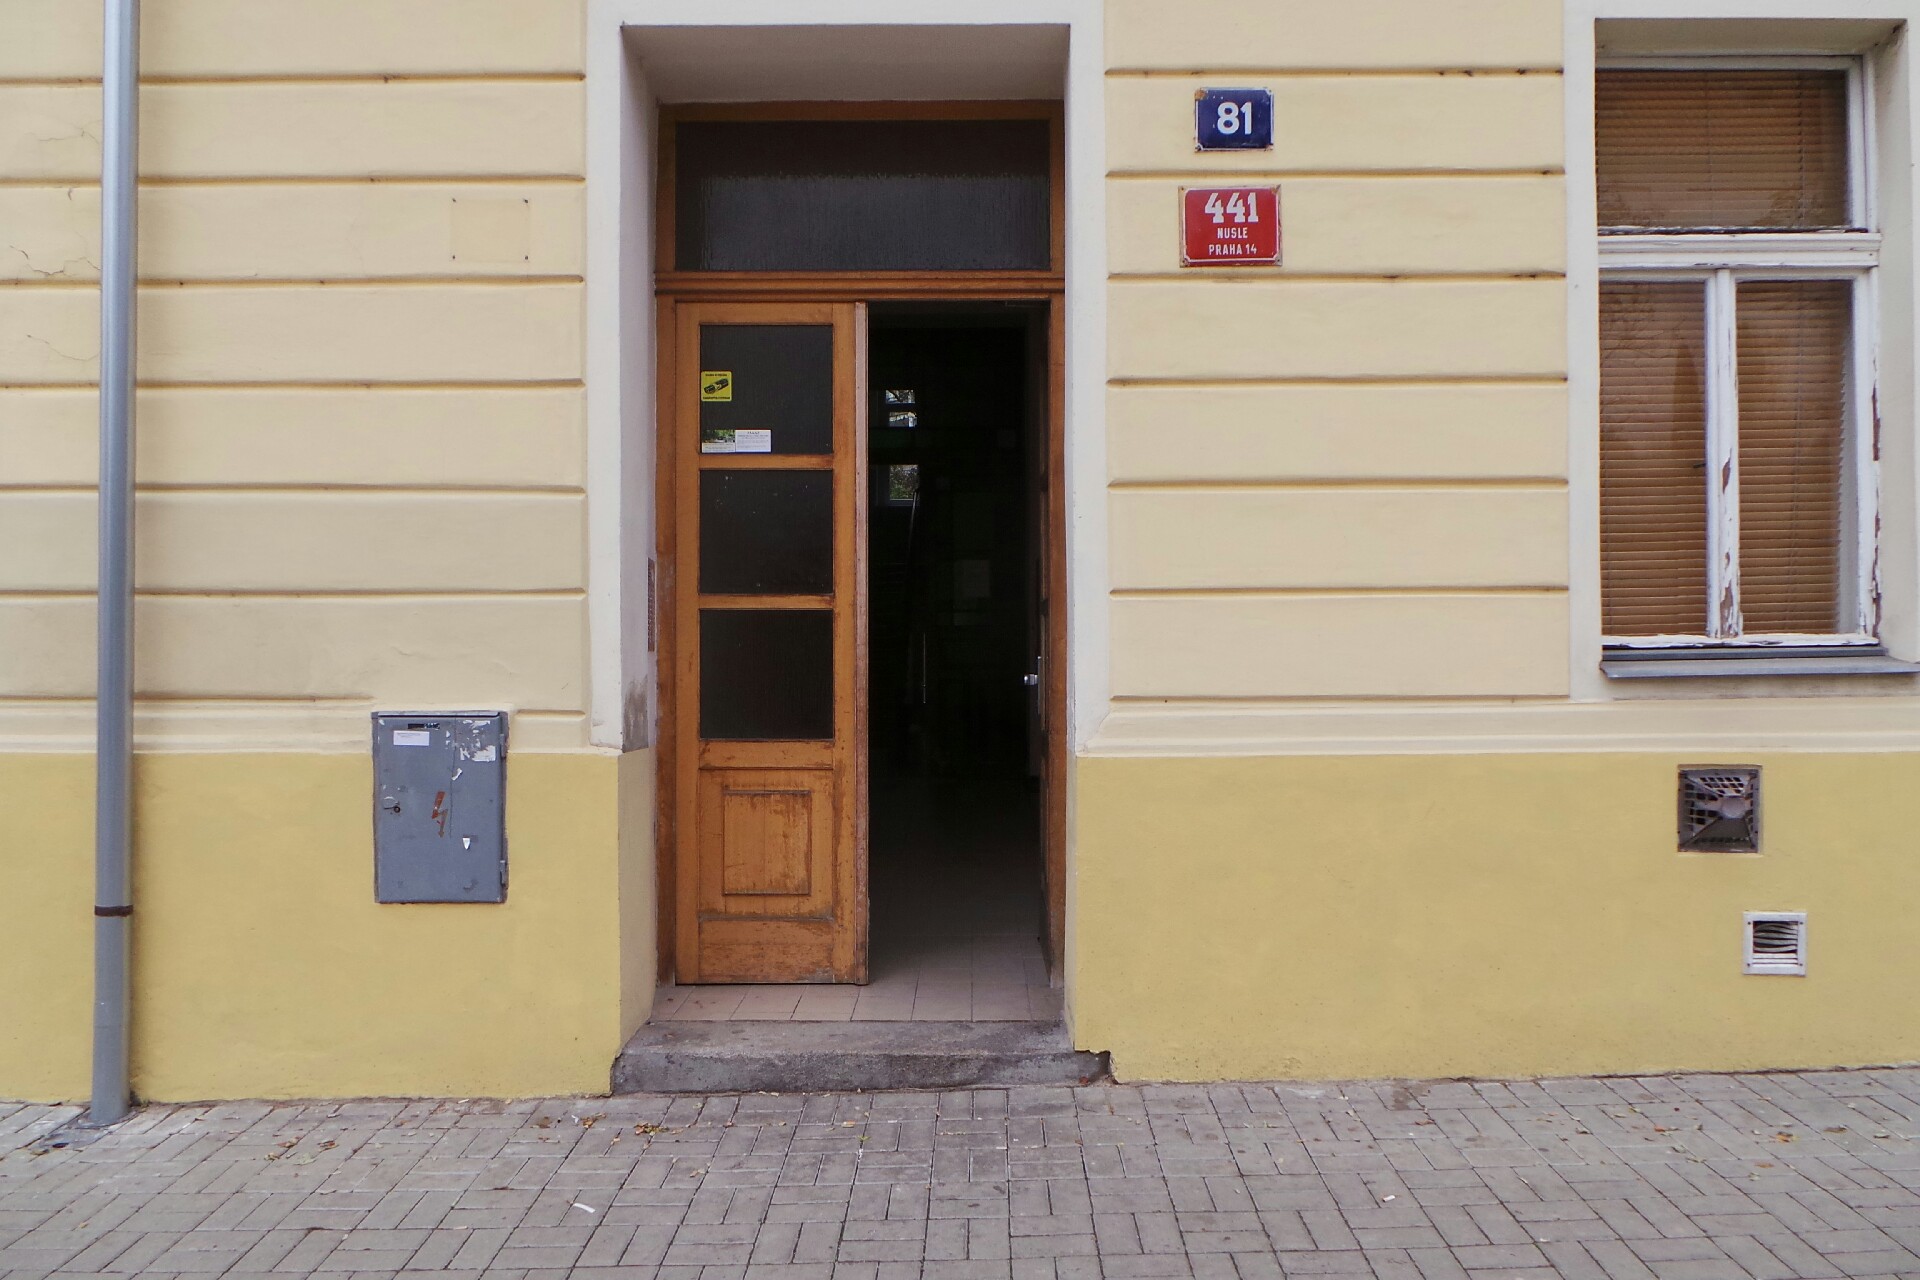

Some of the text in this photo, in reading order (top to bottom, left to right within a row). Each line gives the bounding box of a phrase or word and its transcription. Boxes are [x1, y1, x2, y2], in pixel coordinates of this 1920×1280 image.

[1217, 101, 1252, 135] 81
[1204, 192, 1259, 224] 441
[1217, 227, 1248, 239] NUSLE
[1208, 243, 1257, 256] PRAHA 14
